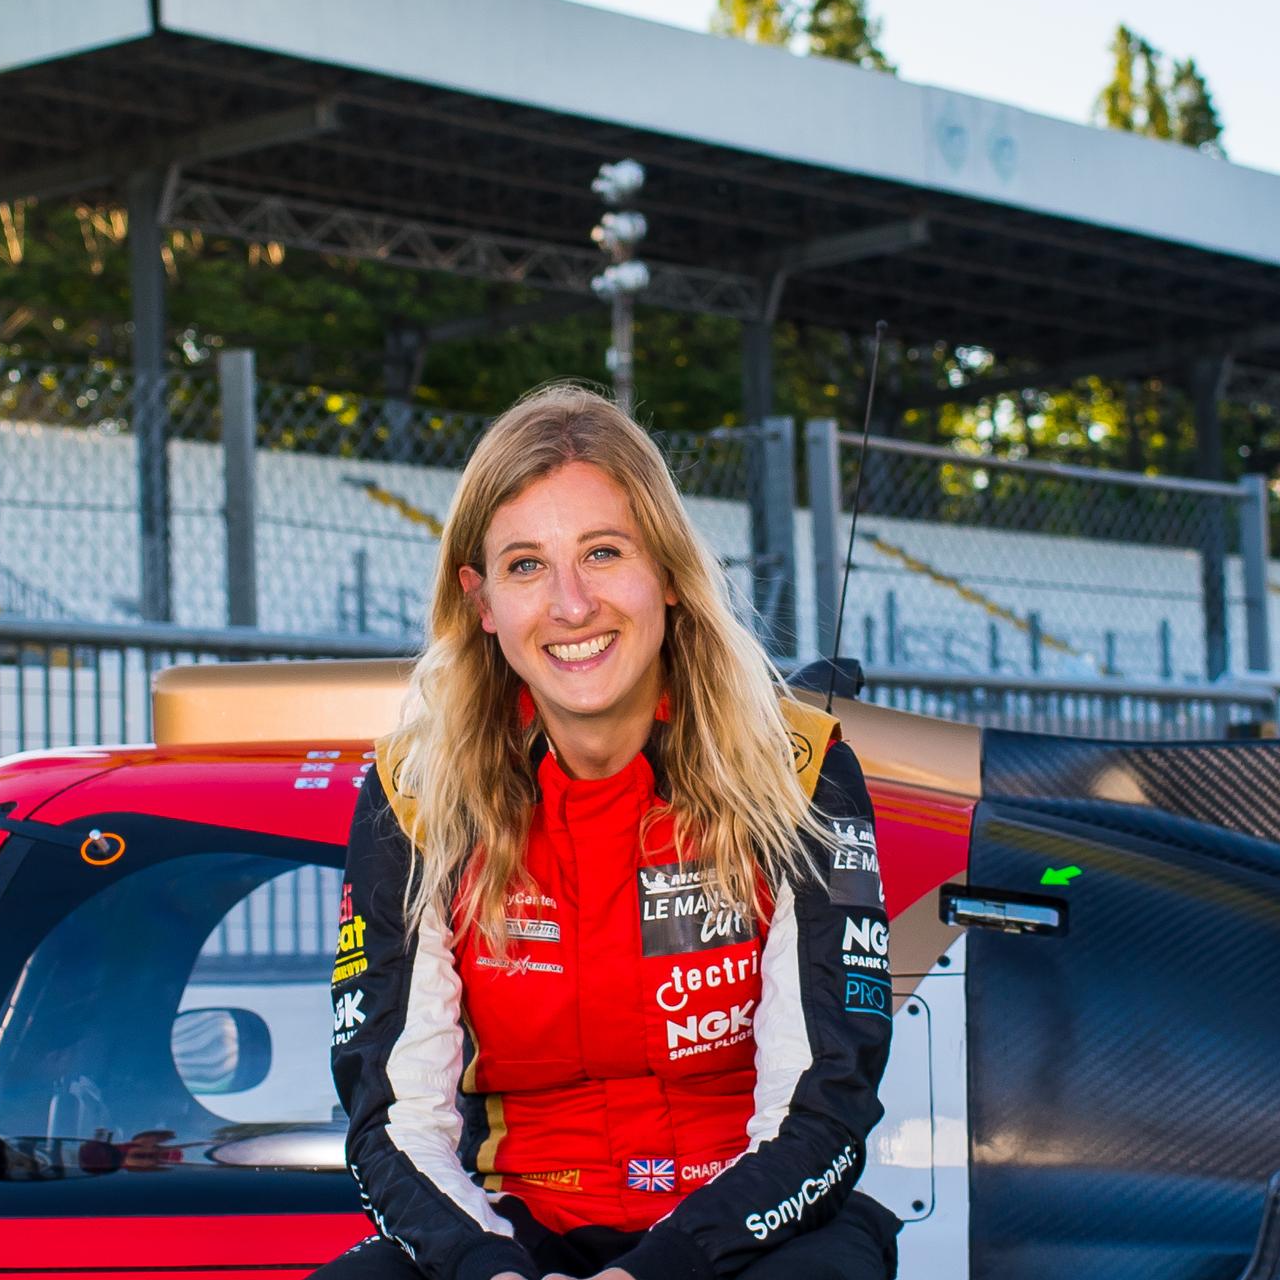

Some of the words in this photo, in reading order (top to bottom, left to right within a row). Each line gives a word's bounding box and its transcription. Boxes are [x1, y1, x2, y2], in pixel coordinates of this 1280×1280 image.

[644, 899, 669, 921] LE
[671, 950, 758, 993] tectri
[843, 954, 882, 969] SPARK
[846, 980, 885, 1010] PRO
[667, 1000, 755, 1050] NGK
[669, 1043, 712, 1061] SPARK
[715, 1029, 753, 1050] PLUGS
